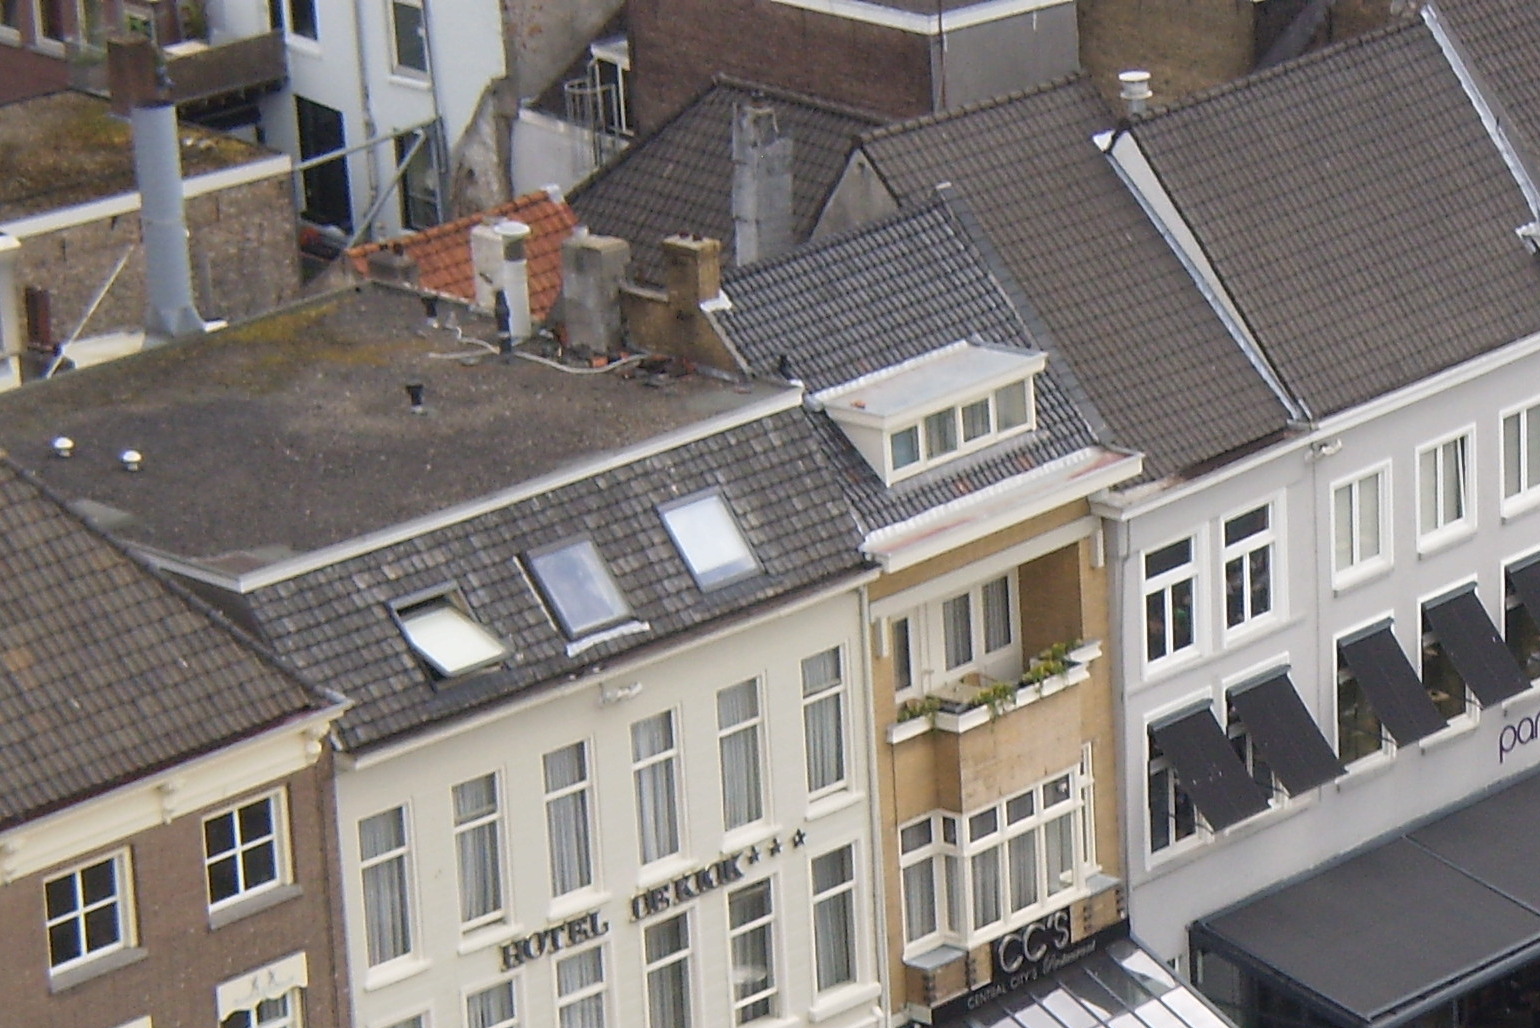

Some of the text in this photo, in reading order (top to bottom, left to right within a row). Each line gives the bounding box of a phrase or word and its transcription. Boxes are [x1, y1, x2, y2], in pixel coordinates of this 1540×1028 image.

[500, 911, 609, 972] HOTEL
[630, 885, 671, 922] DE
[998, 911, 1069, 973] CC'S
